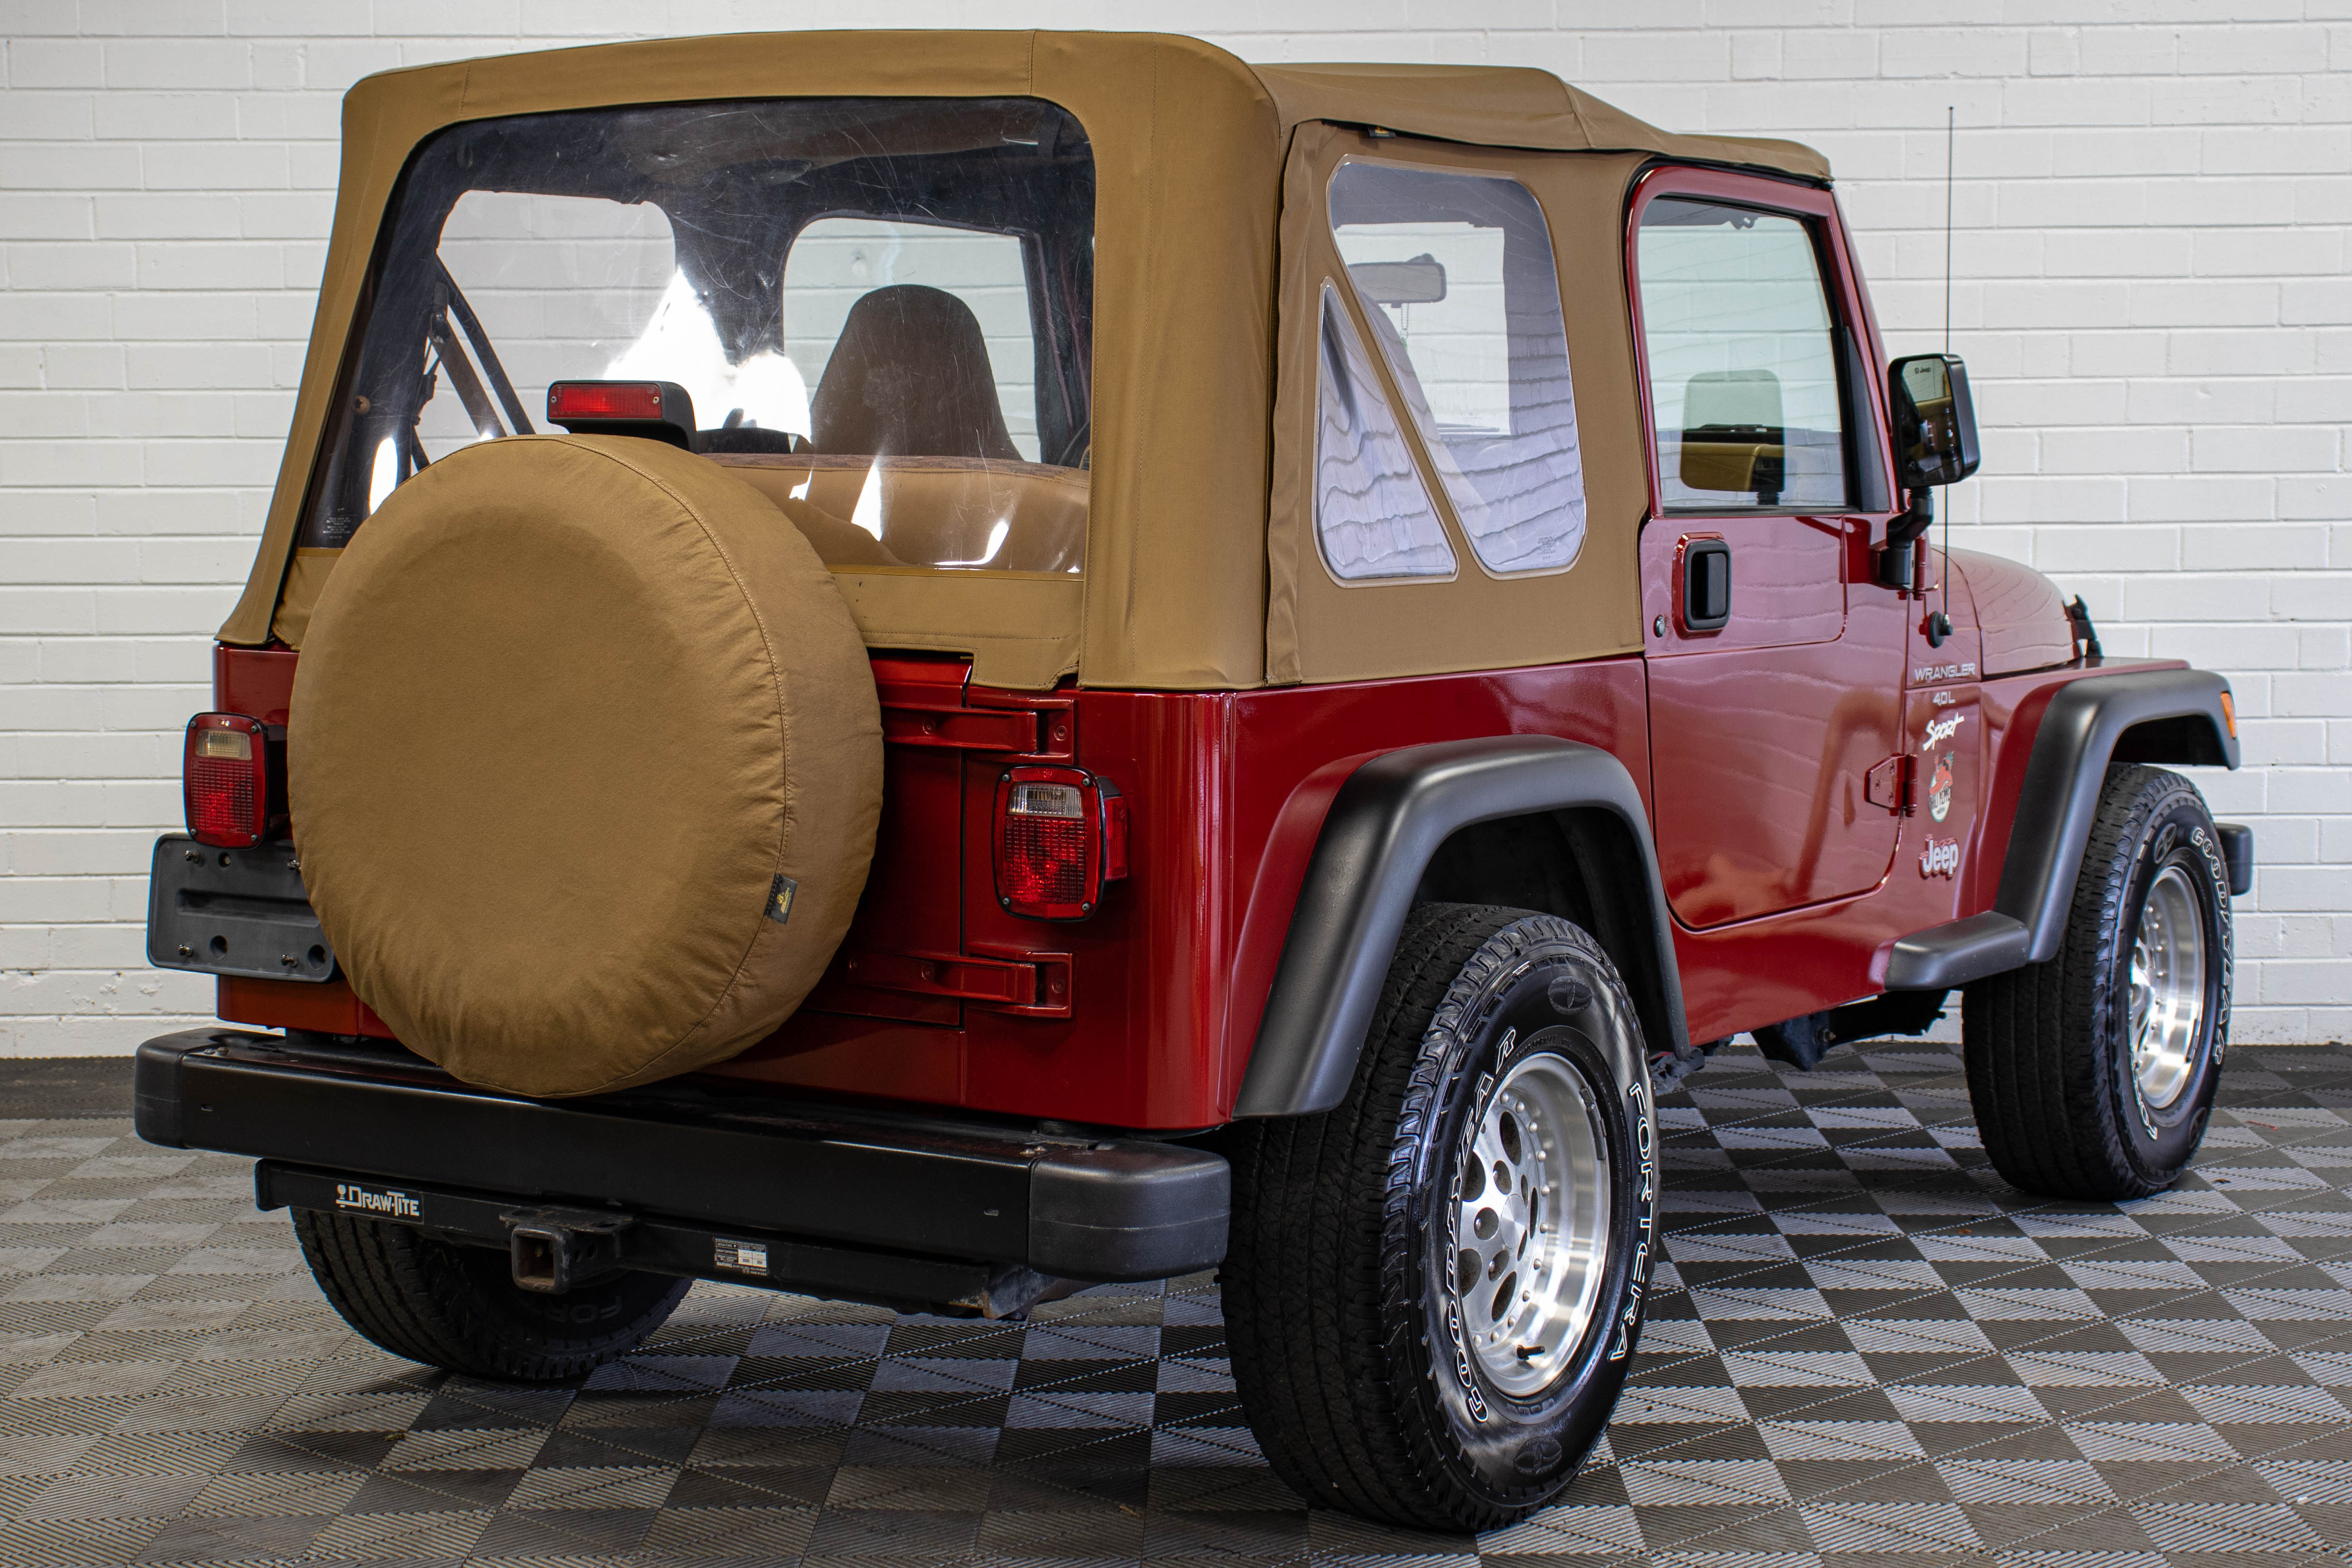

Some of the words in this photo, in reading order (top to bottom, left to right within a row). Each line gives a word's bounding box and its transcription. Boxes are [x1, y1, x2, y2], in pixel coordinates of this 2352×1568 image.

[1914, 662, 1976, 682] WRANGLER
[1922, 712, 1965, 751] Sport
[1920, 836, 1959, 876] Jeep
[1445, 1027, 1516, 1423] GOODYEAR
[1609, 1081, 1653, 1361] FORTERA
